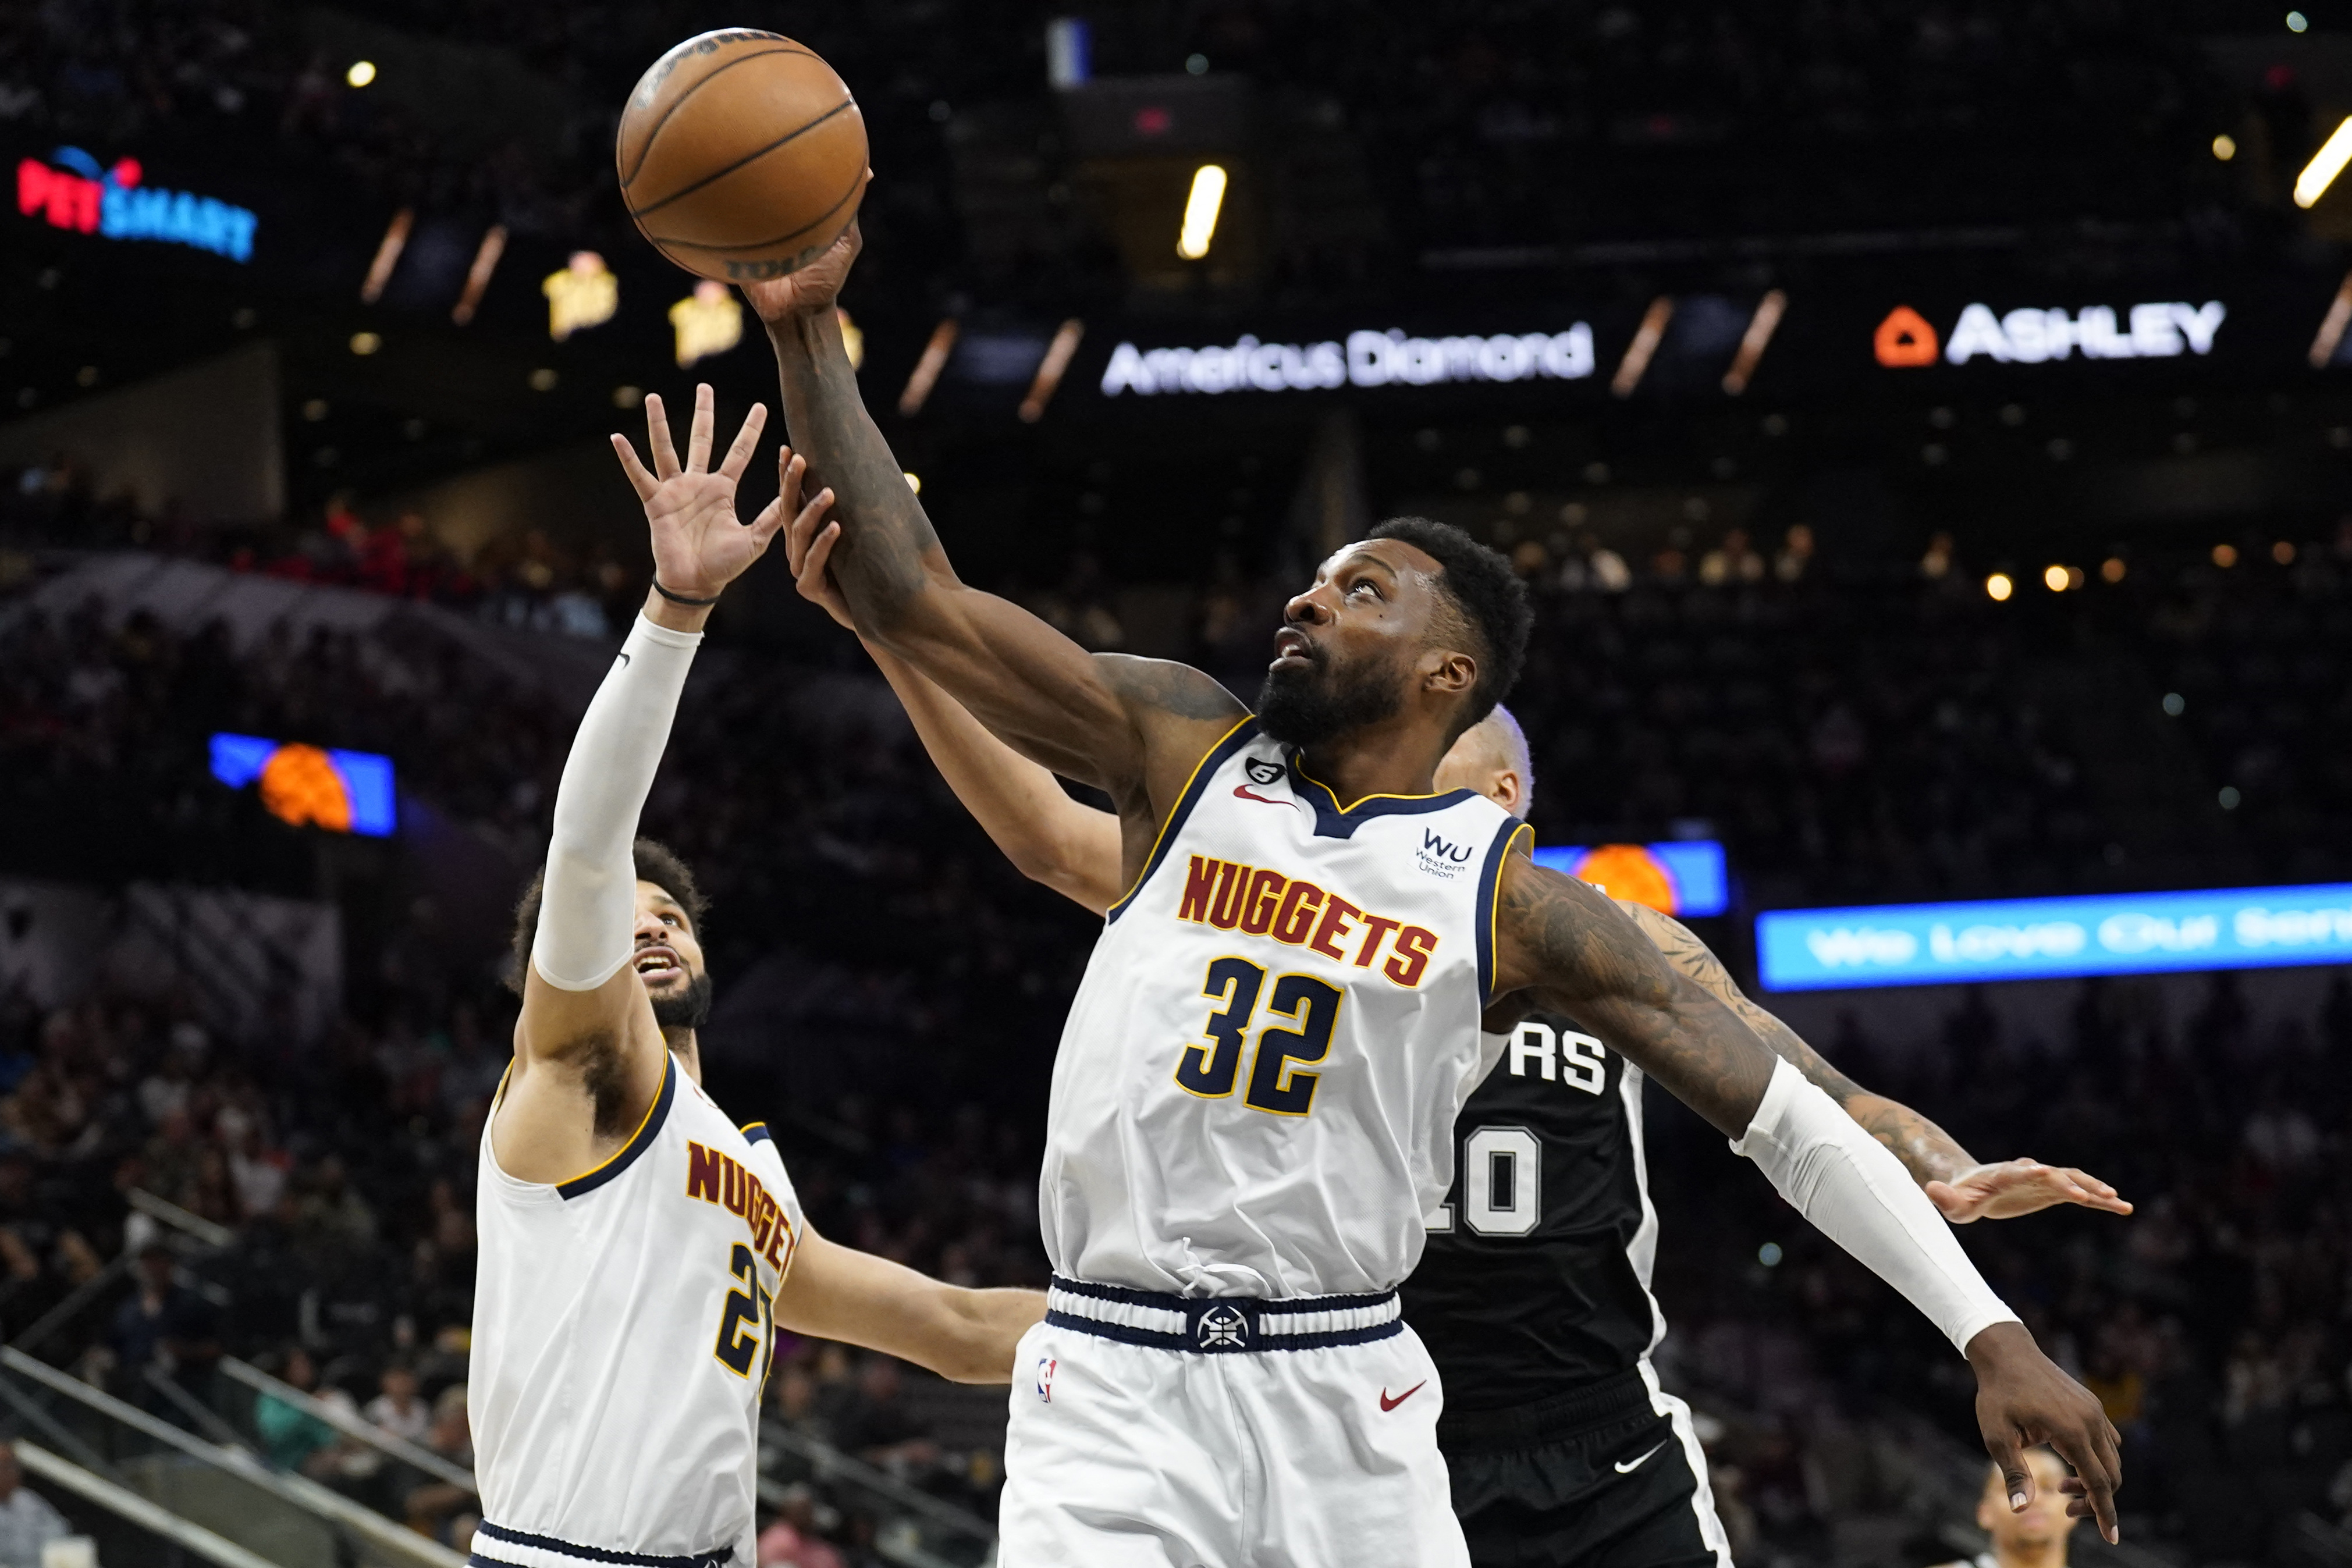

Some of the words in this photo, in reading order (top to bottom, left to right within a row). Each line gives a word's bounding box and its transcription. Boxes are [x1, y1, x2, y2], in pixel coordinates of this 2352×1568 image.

[1347, 321, 1594, 387] Diamond
[1945, 300, 2226, 365] ASHLEY
[1416, 847, 1466, 872] Western
[1419, 861, 1454, 879] Union
[1424, 826, 1473, 862] WU
[1177, 854, 1440, 990] NUGGETS
[1806, 927, 1917, 968] We
[1929, 922, 2087, 963] Love
[2097, 912, 2218, 954] Our
[1174, 955, 1345, 1117] 32
[1425, 1125, 1541, 1237] 0
